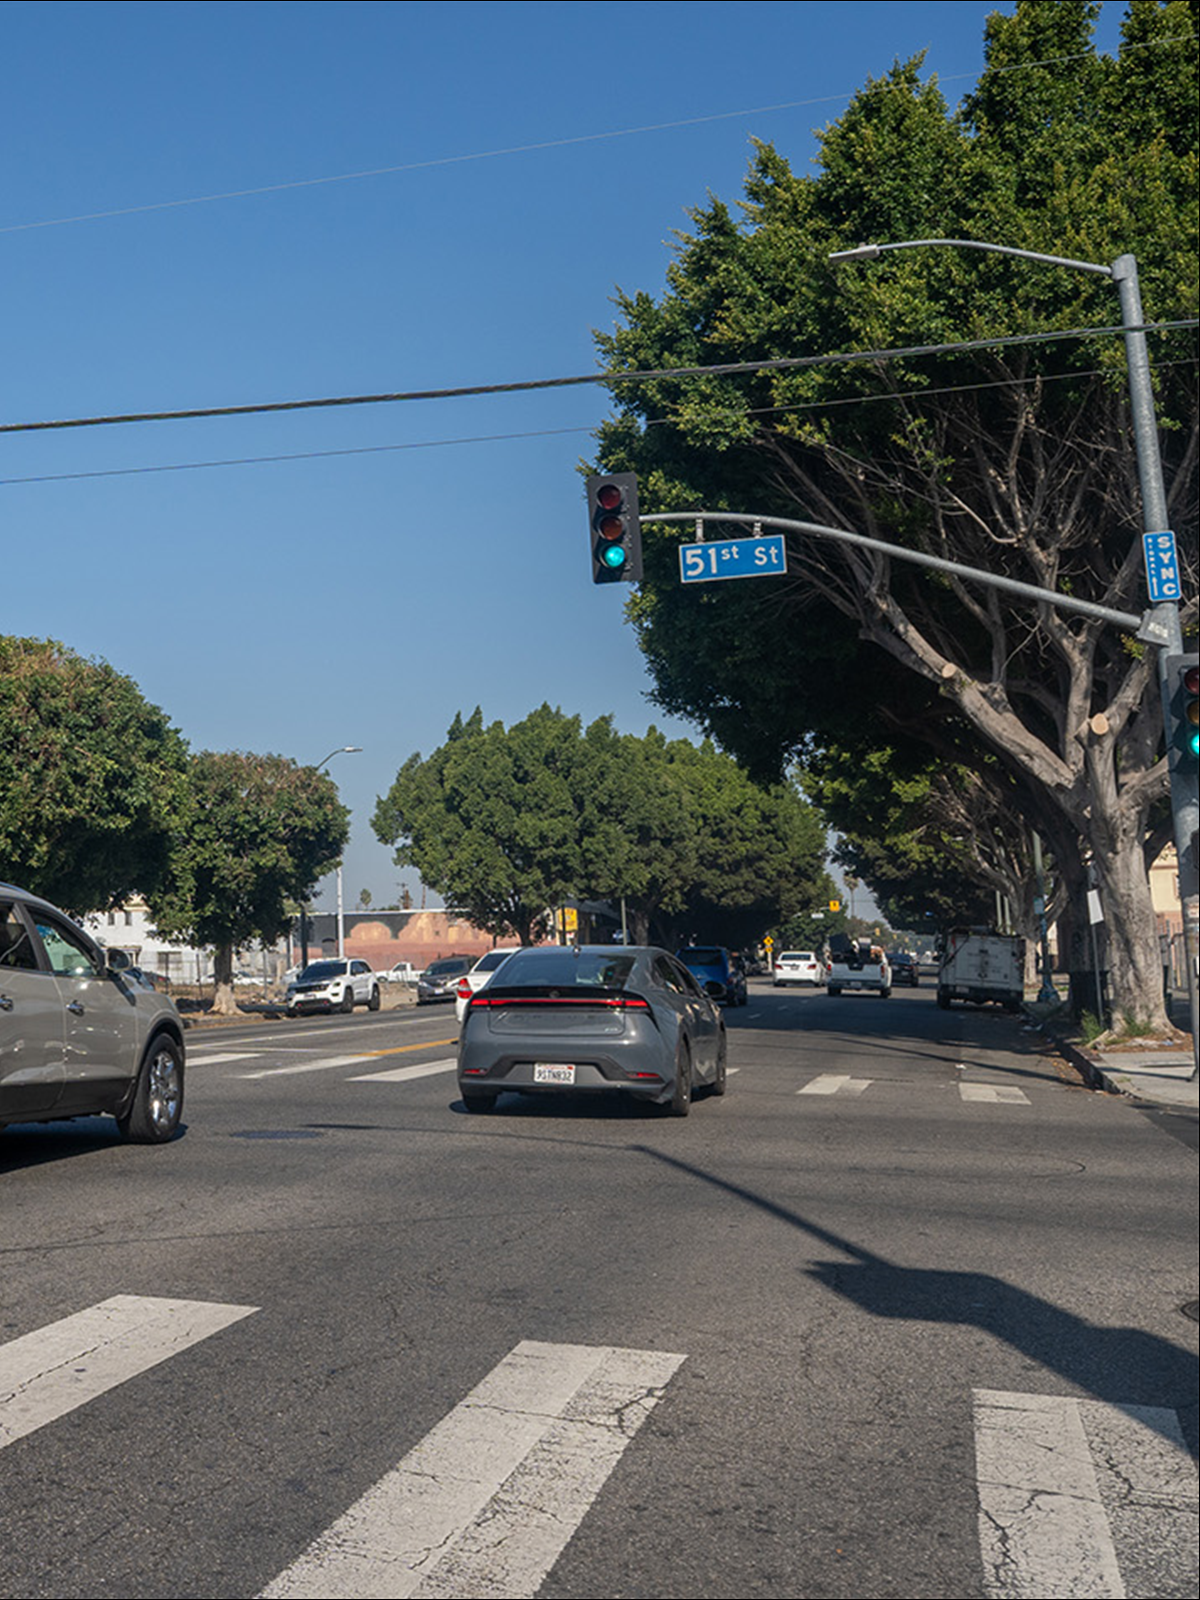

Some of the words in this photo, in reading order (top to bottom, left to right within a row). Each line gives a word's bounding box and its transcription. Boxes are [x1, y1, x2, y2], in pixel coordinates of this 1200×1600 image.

[685, 545, 739, 577] 51st
[754, 546, 779, 565] St
[1157, 536, 1177, 595] SYNC
